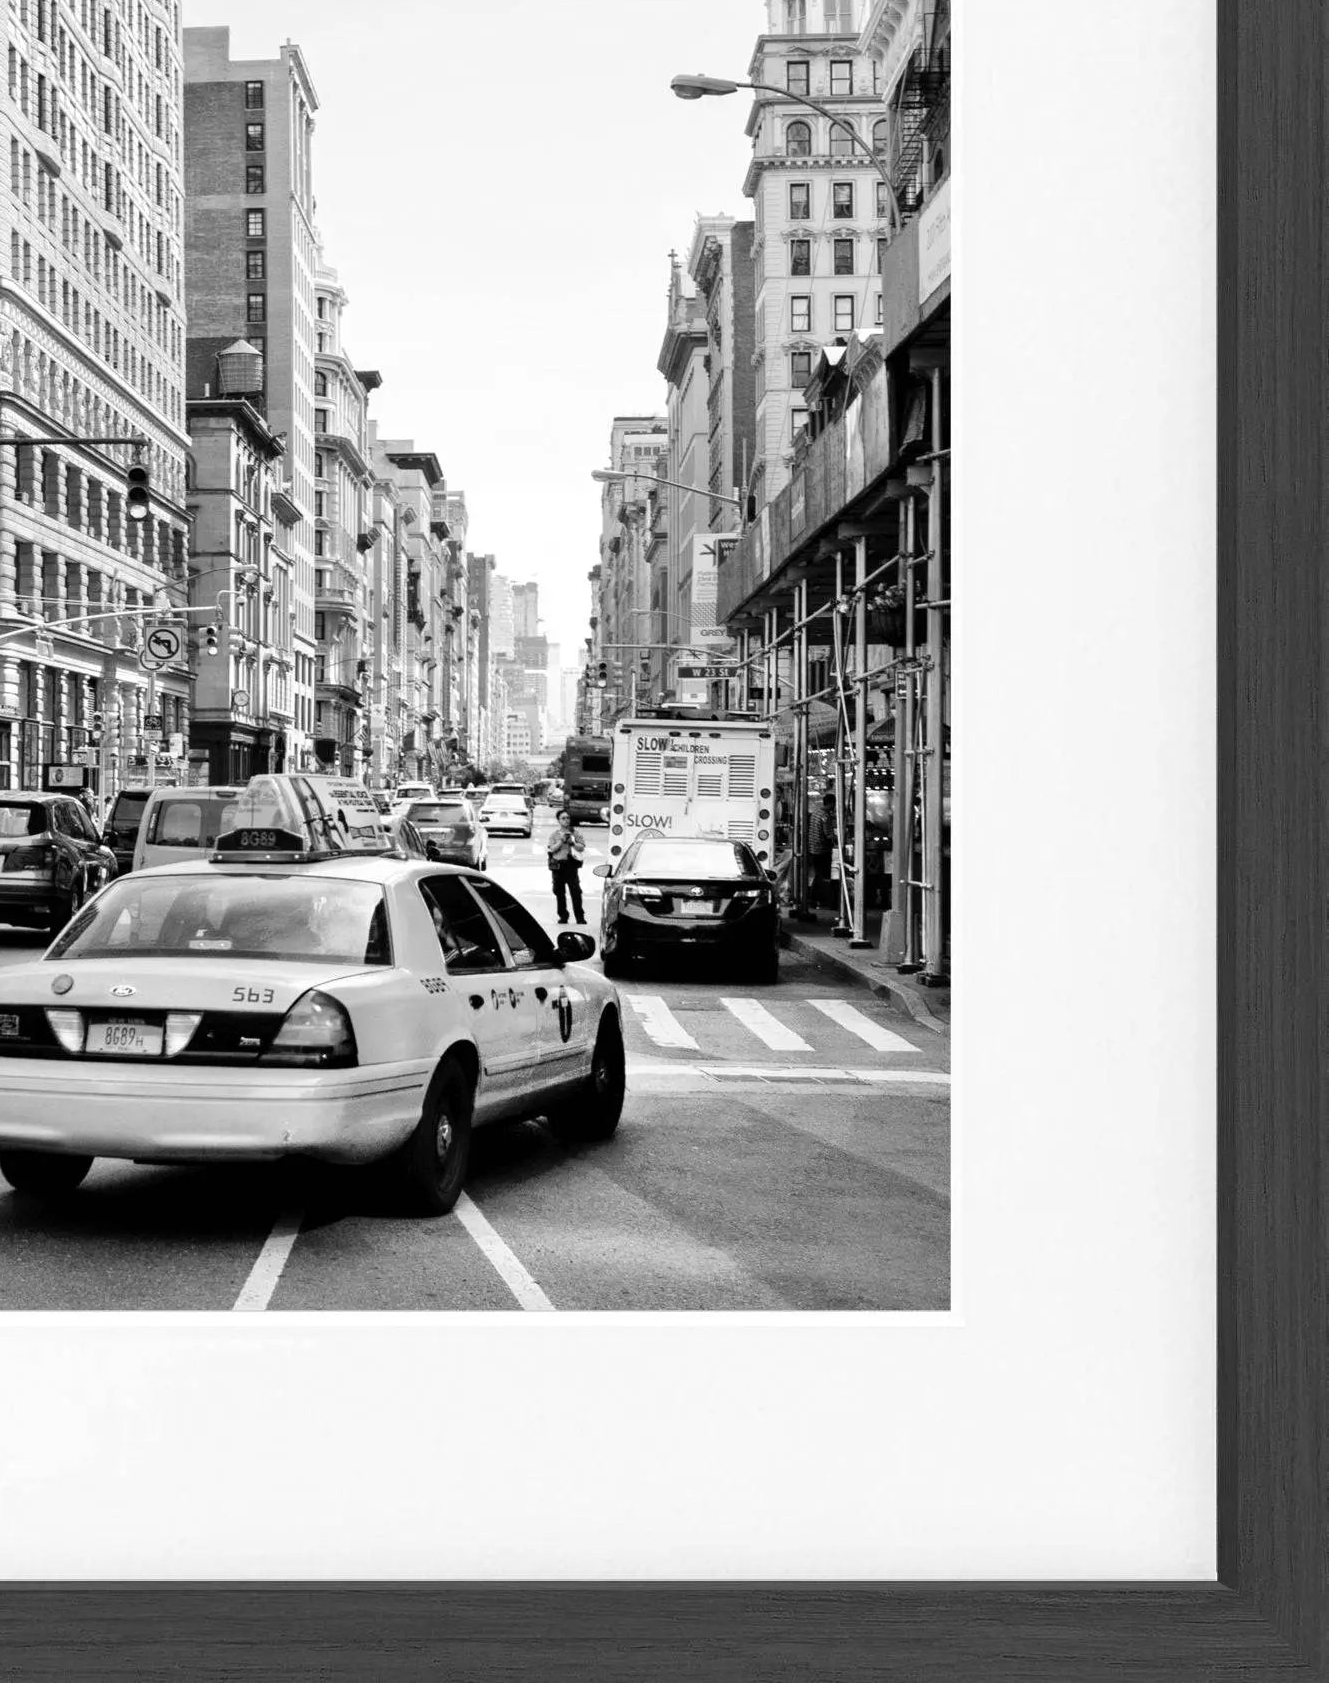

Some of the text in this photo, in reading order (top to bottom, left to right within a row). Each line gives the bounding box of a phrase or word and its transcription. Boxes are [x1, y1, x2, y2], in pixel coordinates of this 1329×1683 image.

[692, 667, 729, 677] W 23 St
[673, 743, 710, 754] CHILDREN
[626, 813, 672, 828] SLOW!
[241, 831, 276, 846] 8G89
[232, 987, 274, 1003] 563
